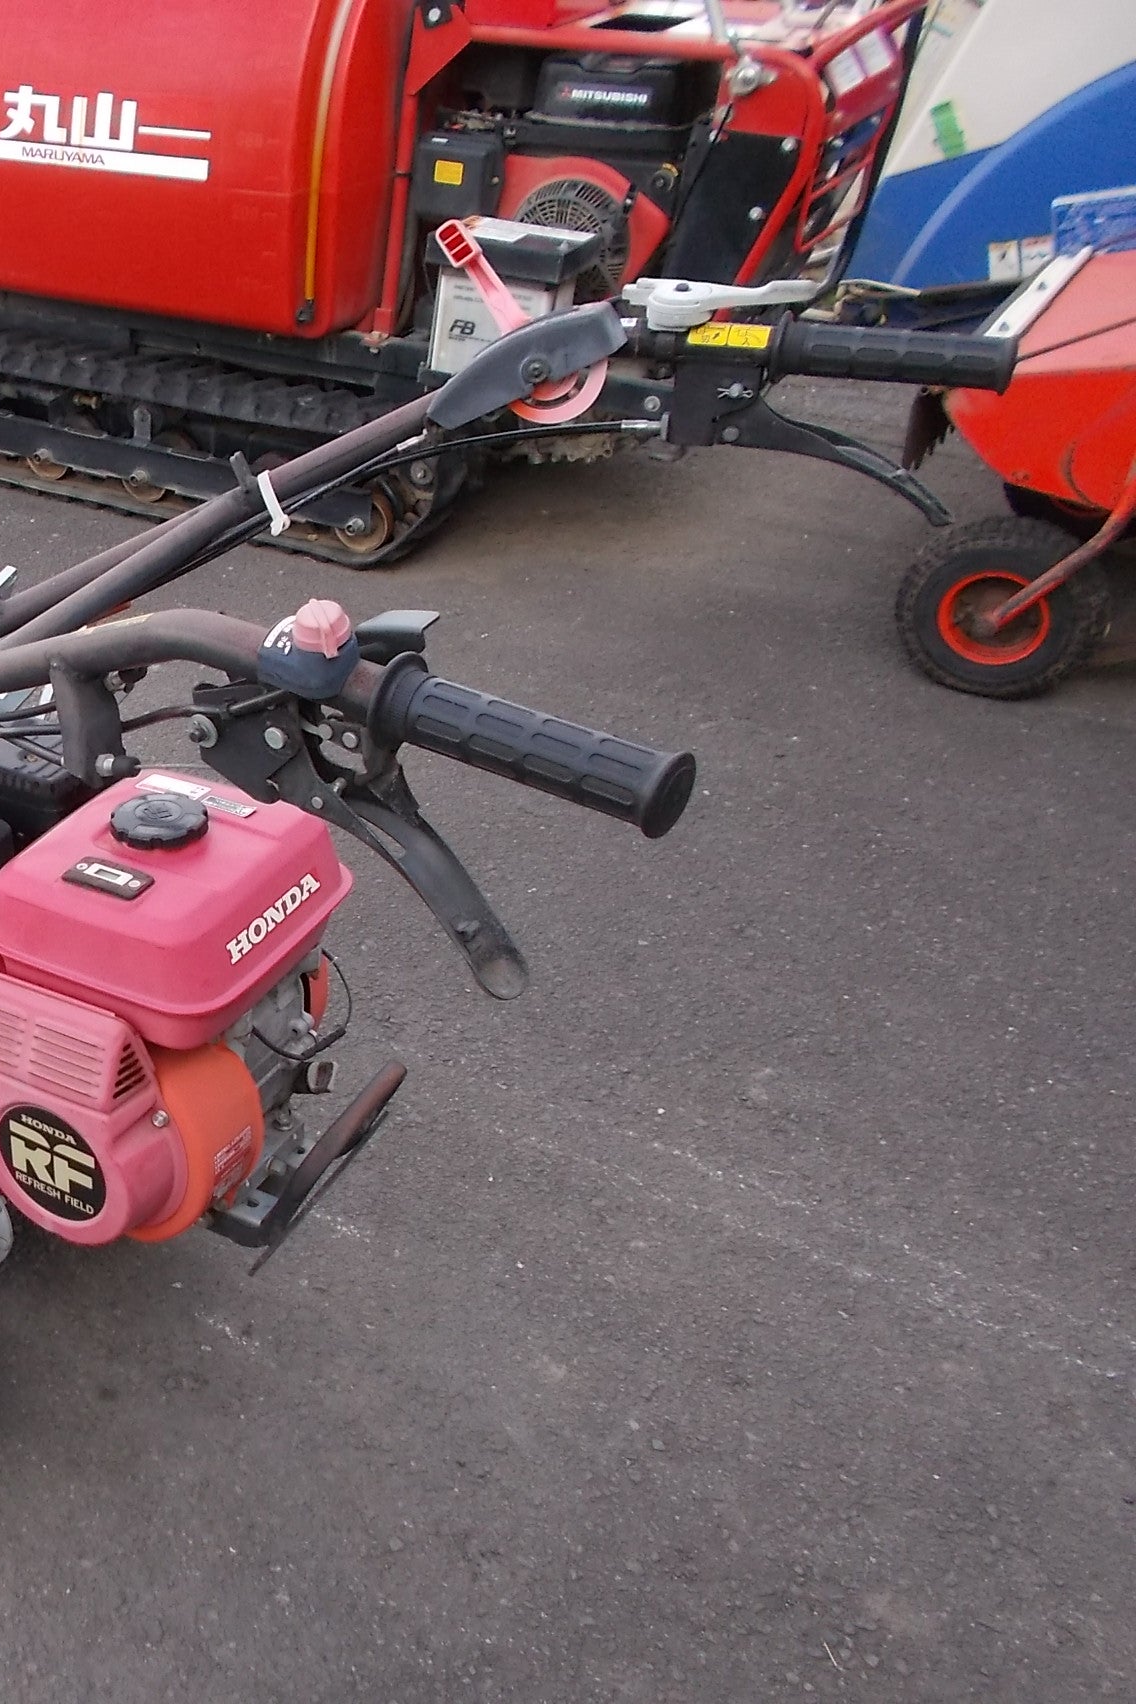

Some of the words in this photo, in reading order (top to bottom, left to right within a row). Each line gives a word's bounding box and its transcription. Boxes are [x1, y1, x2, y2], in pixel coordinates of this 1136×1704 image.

[571, 89, 648, 103] MITSUBISHI
[22, 146, 105, 166] MARUYAMA
[449, 318, 476, 336] FB
[226, 873, 321, 965] HONDA
[21, 1113, 77, 1146] HONDA
[9, 1119, 96, 1194] RF
[15, 1170, 61, 1200] REFRESH
[64, 1194, 94, 1215] FIELD
